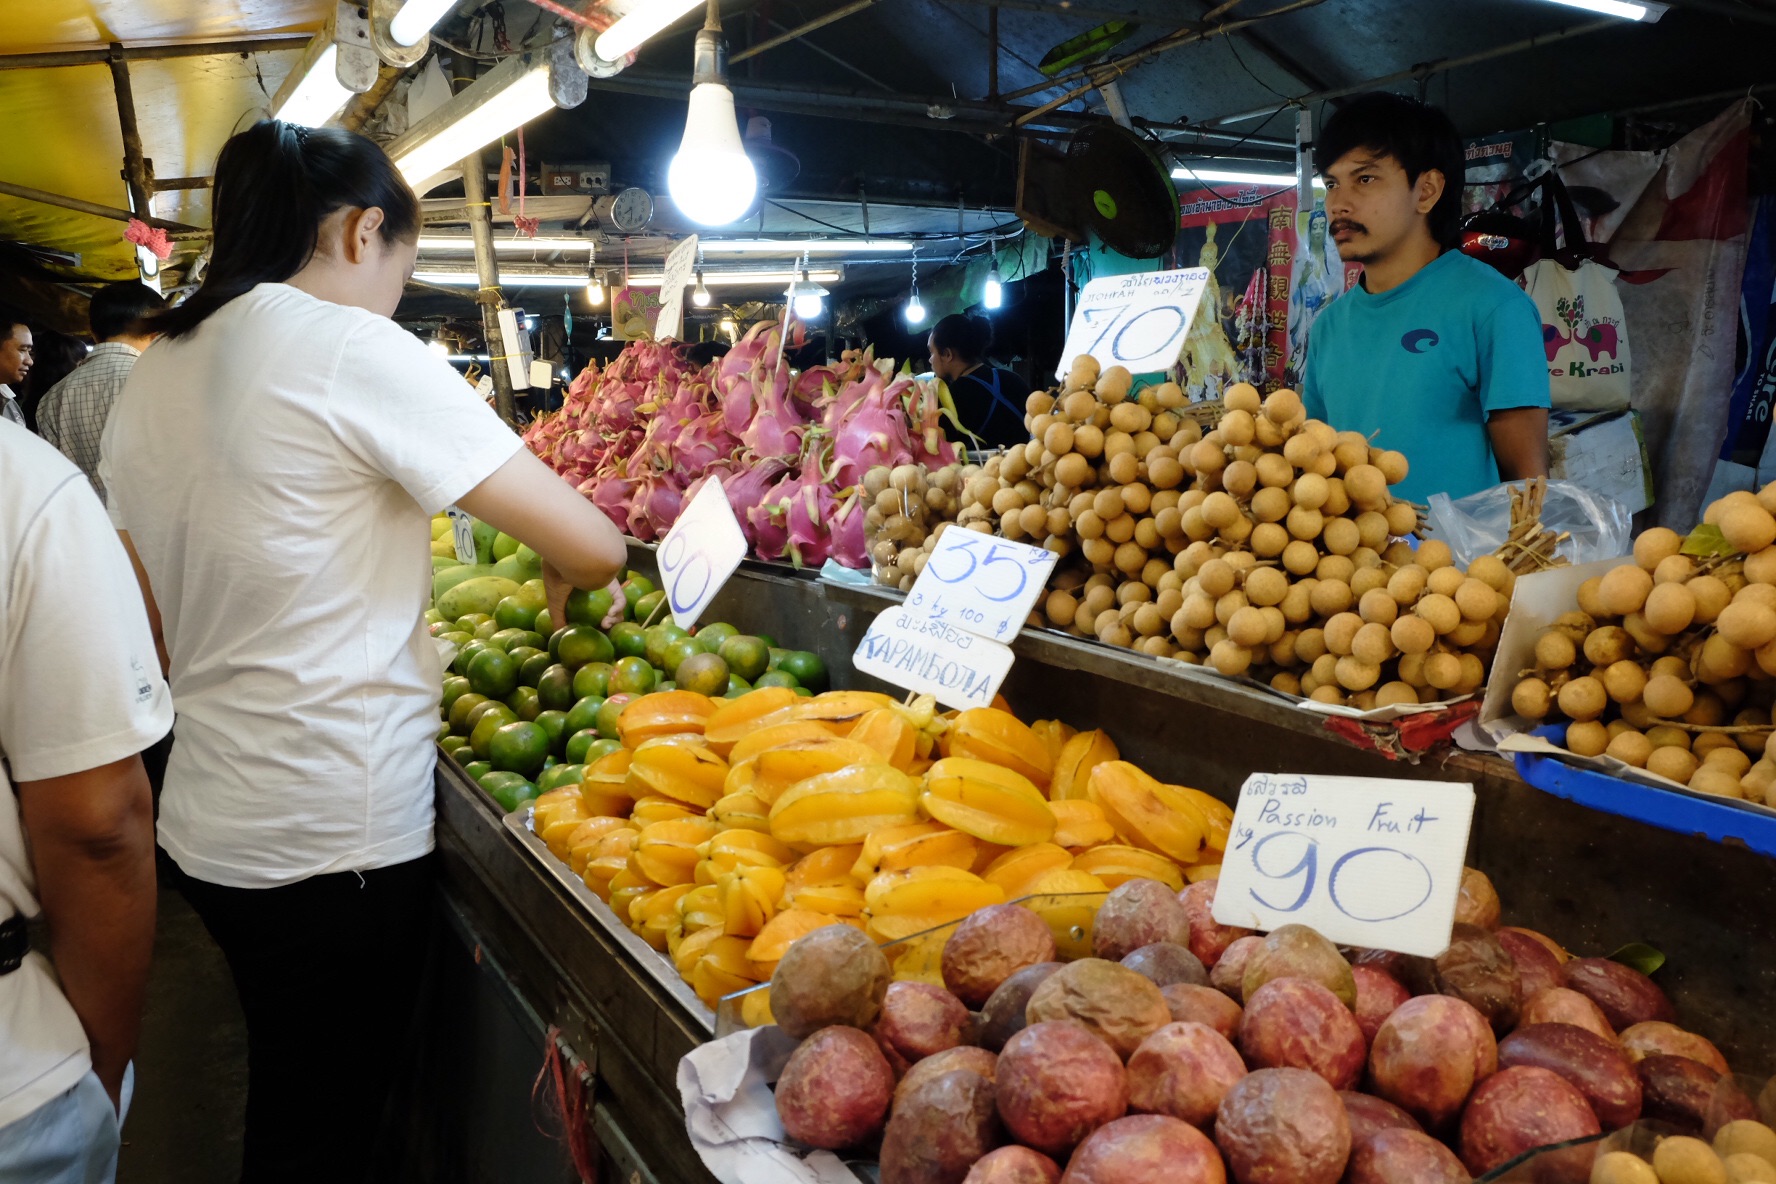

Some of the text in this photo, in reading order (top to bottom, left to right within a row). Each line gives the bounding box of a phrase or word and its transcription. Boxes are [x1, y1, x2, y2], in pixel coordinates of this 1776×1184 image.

[1083, 302, 1186, 361] 70
[927, 531, 1028, 602] 35
[912, 592, 923, 606] 3
[959, 608, 985, 624] 100
[1257, 799, 1439, 834] Passion Fruit
[1249, 830, 1433, 922] 90
